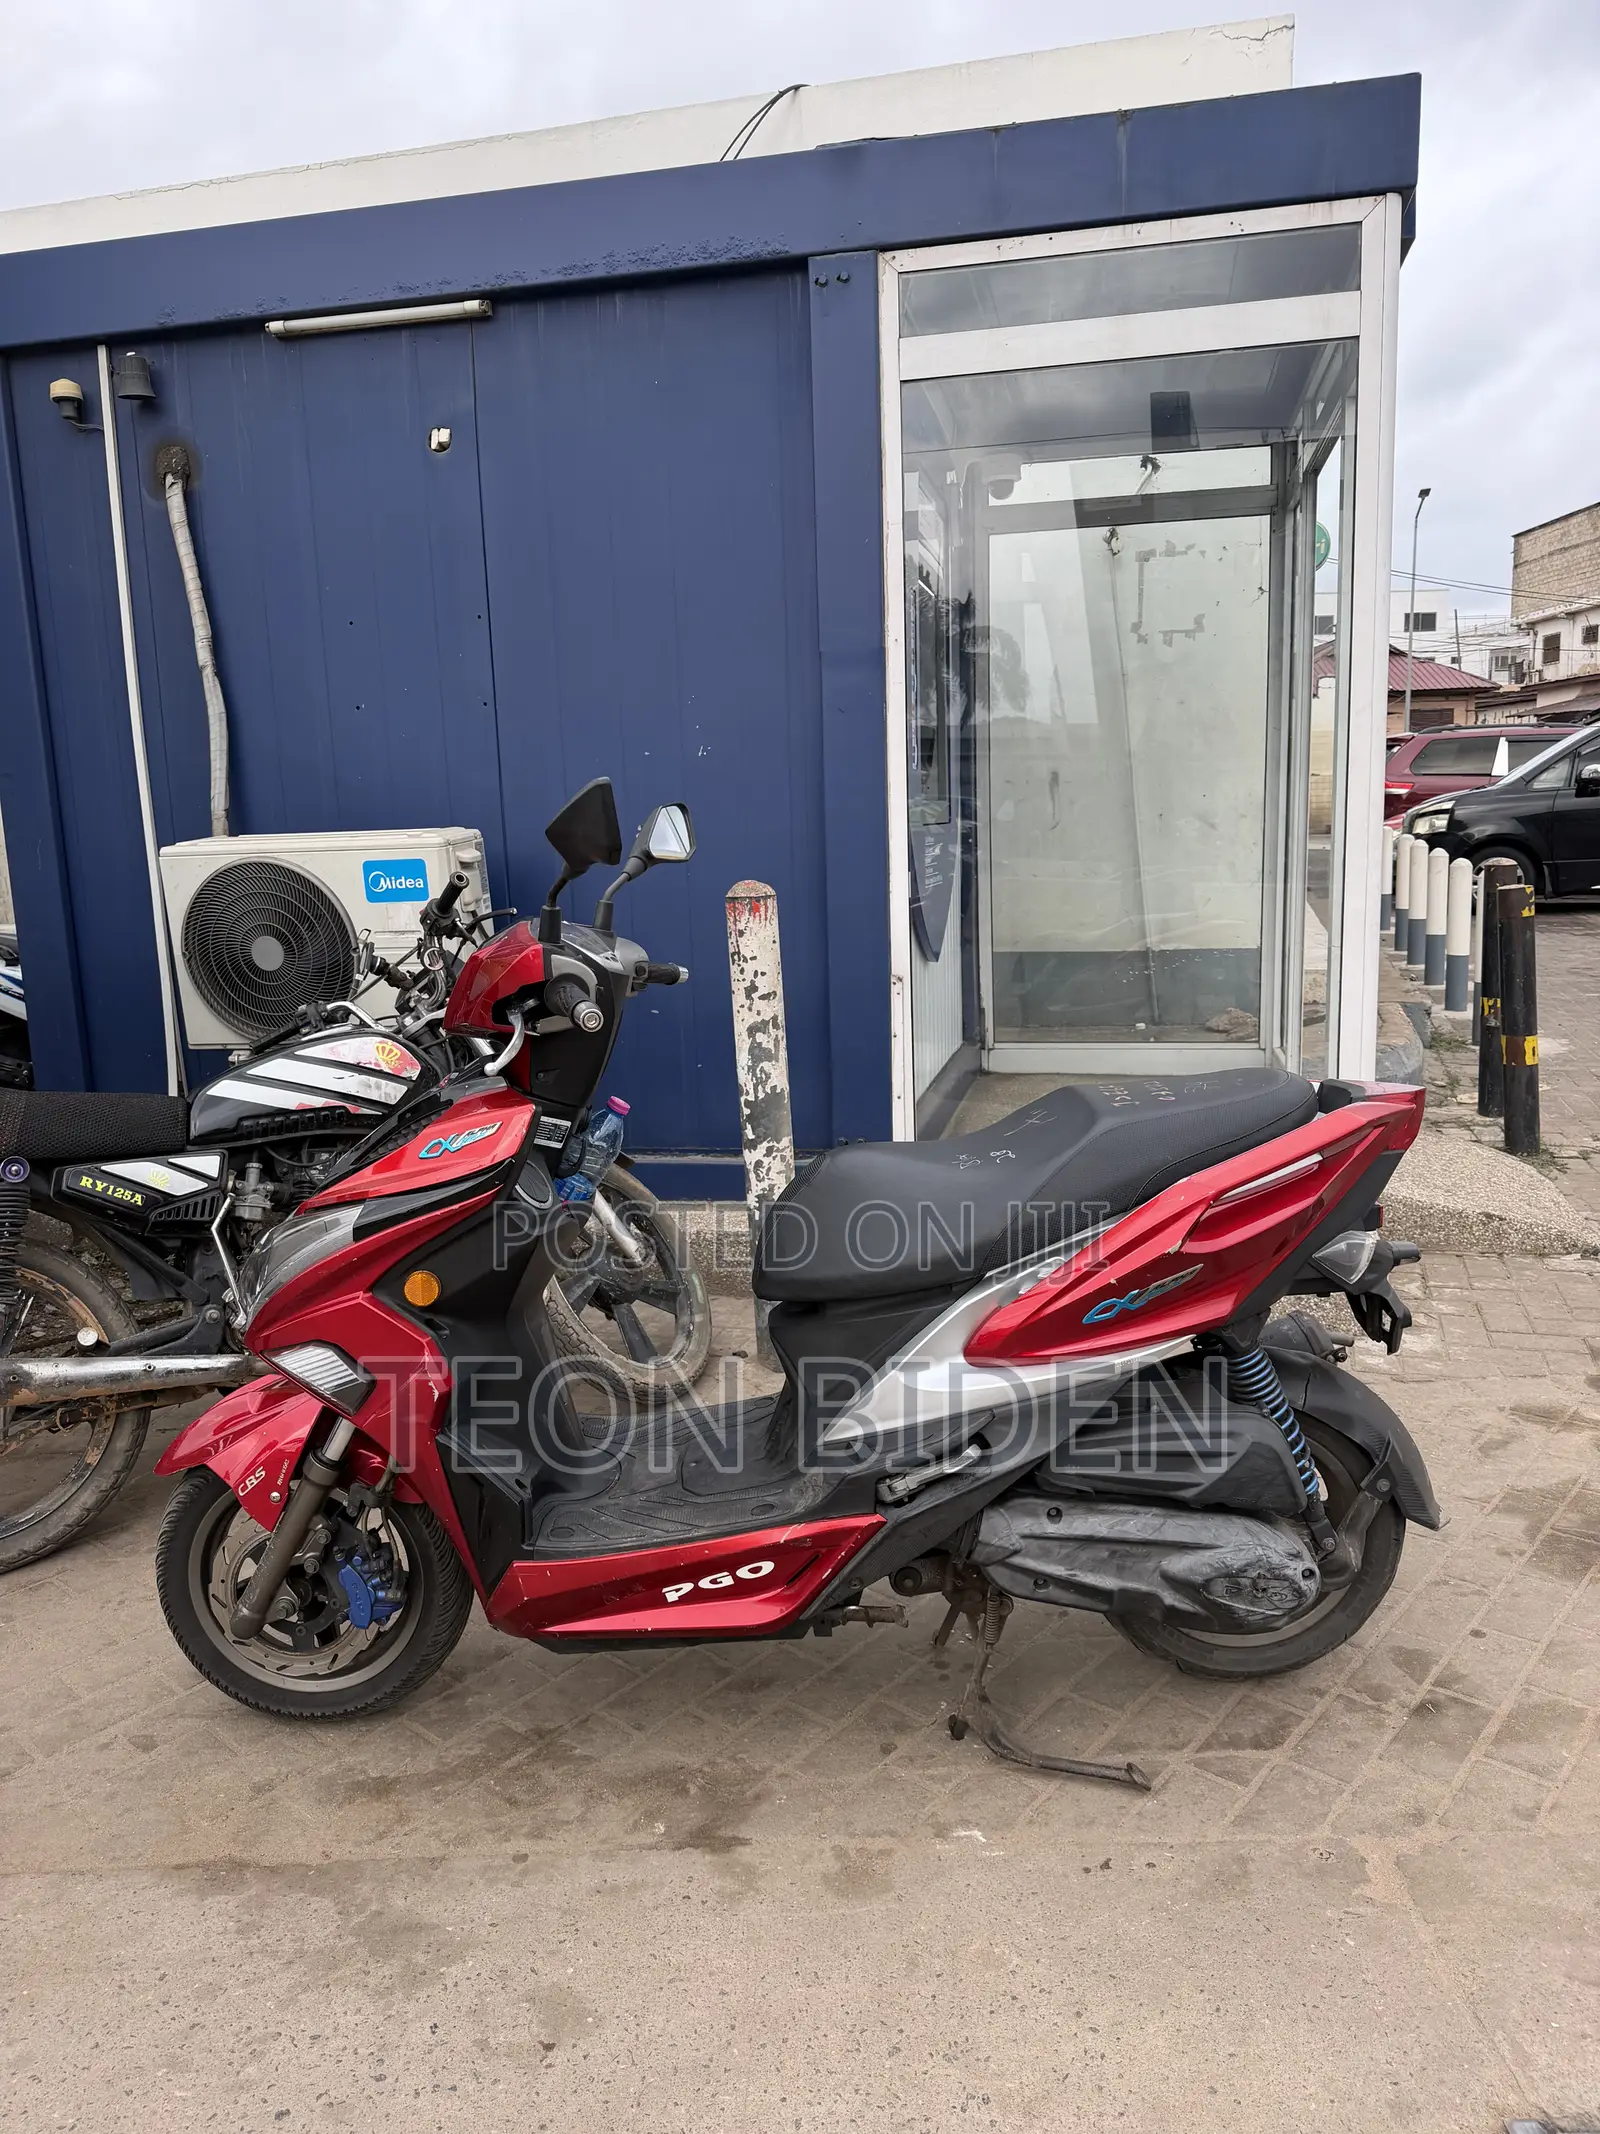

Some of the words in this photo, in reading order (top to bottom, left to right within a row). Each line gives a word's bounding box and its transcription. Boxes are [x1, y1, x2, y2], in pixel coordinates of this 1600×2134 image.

[369, 871, 424, 892] Midea
[79, 1175, 143, 1206] RY125A
[238, 1466, 266, 1496] CBS
[661, 1560, 775, 1603] PGO
